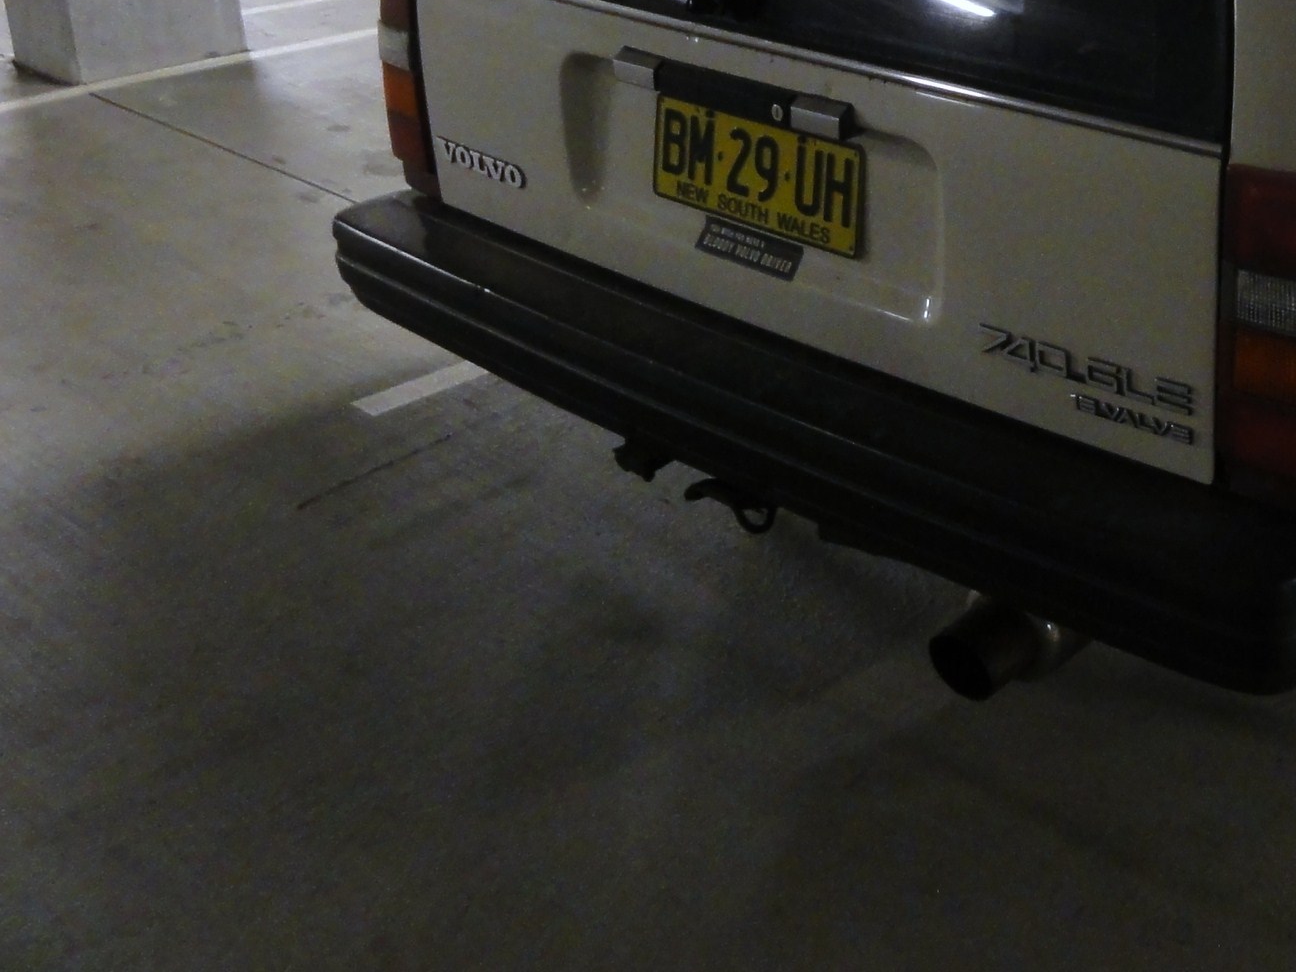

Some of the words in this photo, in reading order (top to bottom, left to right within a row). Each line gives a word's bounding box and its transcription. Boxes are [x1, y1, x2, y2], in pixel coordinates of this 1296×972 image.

[436, 135, 528, 189] VOLVO
[676, 180, 709, 203] NEW
[717, 193, 769, 224] SOUTH
[777, 211, 831, 244] WALES
